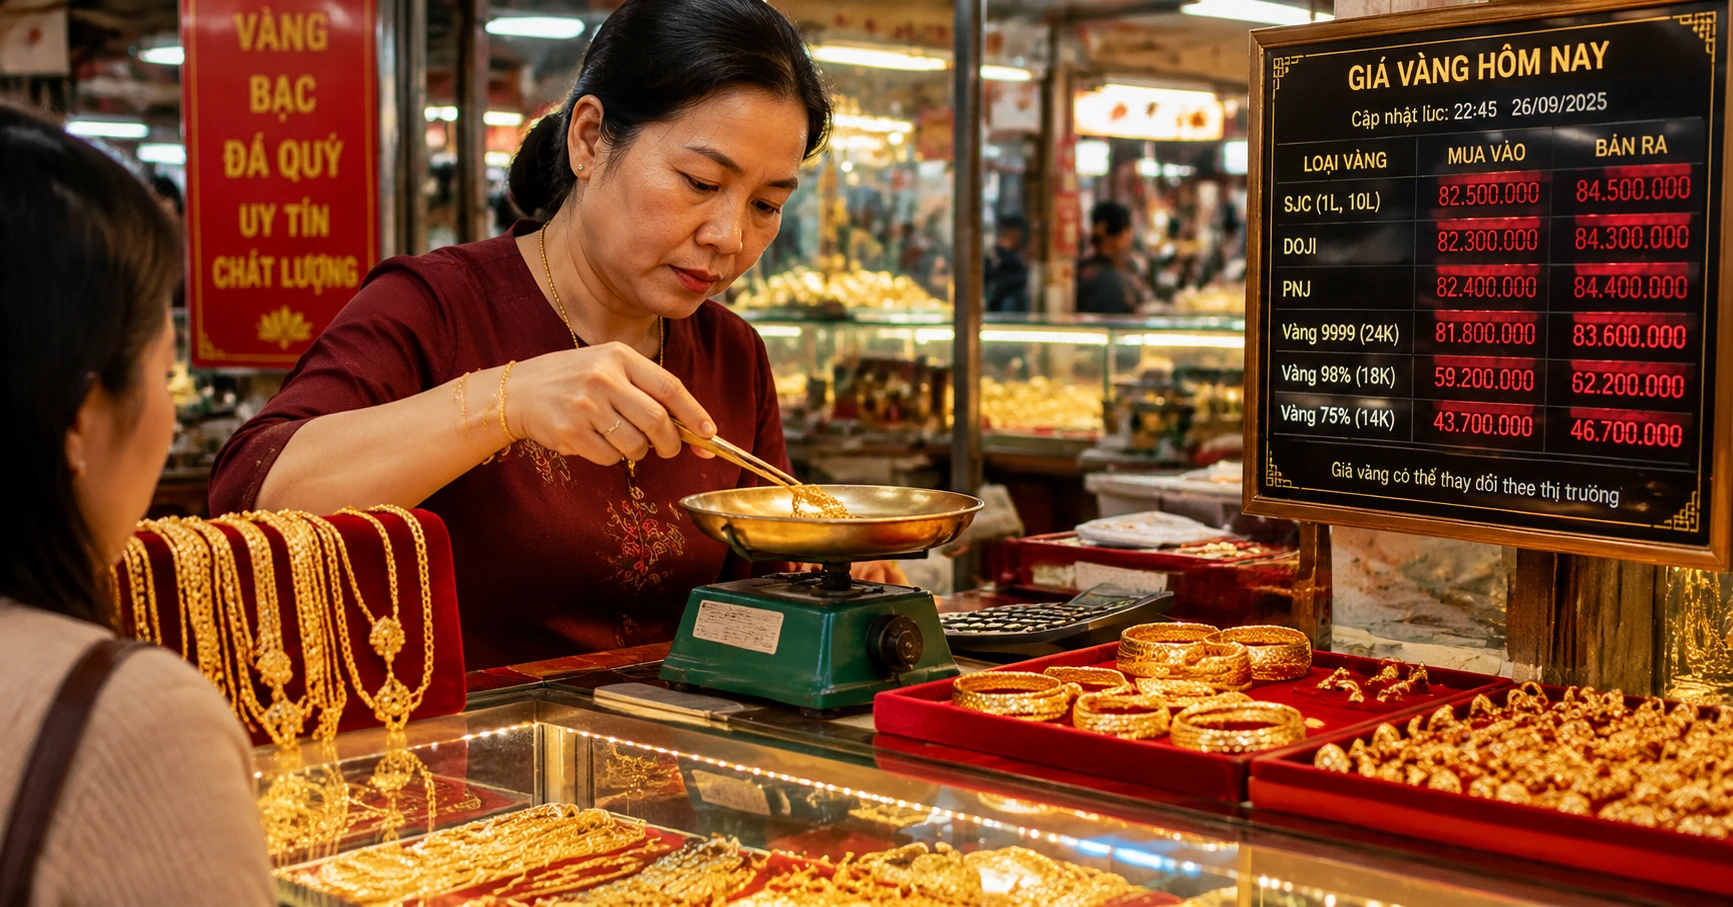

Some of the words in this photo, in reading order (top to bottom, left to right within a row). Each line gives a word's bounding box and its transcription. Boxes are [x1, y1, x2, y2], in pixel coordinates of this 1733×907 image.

[234, 5, 329, 51] VÀNG
[1348, 56, 1390, 91] GIÁ
[1397, 52, 1469, 86] VÀNG
[1478, 43, 1541, 80] HÔM
[1550, 40, 1610, 74] NAY
[249, 74, 317, 123] BẠC
[1351, 110, 1380, 130] Cập
[1384, 106, 1418, 127] nhật
[1453, 101, 1498, 120] 22:45
[1511, 92, 1608, 116] 26/09/2025
[223, 130, 271, 180] ĐÁ
[1447, 146, 1486, 165] MUA
[1641, 134, 1668, 155] RA
[1303, 154, 1339, 175] LOẠI
[1343, 149, 1387, 169] VÀNG
[1438, 182, 1540, 207] 82.500.000
[1576, 175, 1691, 203] 84.500.000
[1284, 195, 1312, 213] SJC
[1316, 194, 1343, 215] (1L,
[1348, 191, 1381, 213] 10L)
[238, 202, 277, 239] UY
[282, 195, 330, 239] TÍN
[1283, 237, 1317, 255] DOJI
[1437, 229, 1539, 252] 82.300.000
[1575, 225, 1690, 250] 84.300.000
[1282, 280, 1311, 298] PNJ
[1436, 276, 1537, 298] 82.400.000
[1574, 275, 1688, 299] 84.400.000
[1282, 322, 1317, 345] Vàng
[1321, 323, 1356, 341] 9999
[1360, 323, 1399, 346] (24K)
[1435, 322, 1536, 345] 81.800.000
[1573, 324, 1687, 349] 83.600.000
[1281, 364, 1317, 386] Vàng
[1320, 365, 1351, 384] 98%
[1355, 365, 1396, 389] (18K)
[1434, 367, 1535, 392] 59.200.000
[1572, 372, 1685, 399] 62.200.000
[1280, 404, 1316, 427] Vàng
[1319, 406, 1351, 425] 75%
[1355, 408, 1395, 432] (14K)
[1433, 411, 1533, 438] 43.700.000
[1570, 419, 1683, 448] 46.700.000
[1441, 471, 1472, 494] thay
[1502, 477, 1536, 497] thee
[1540, 480, 1560, 502] thị
